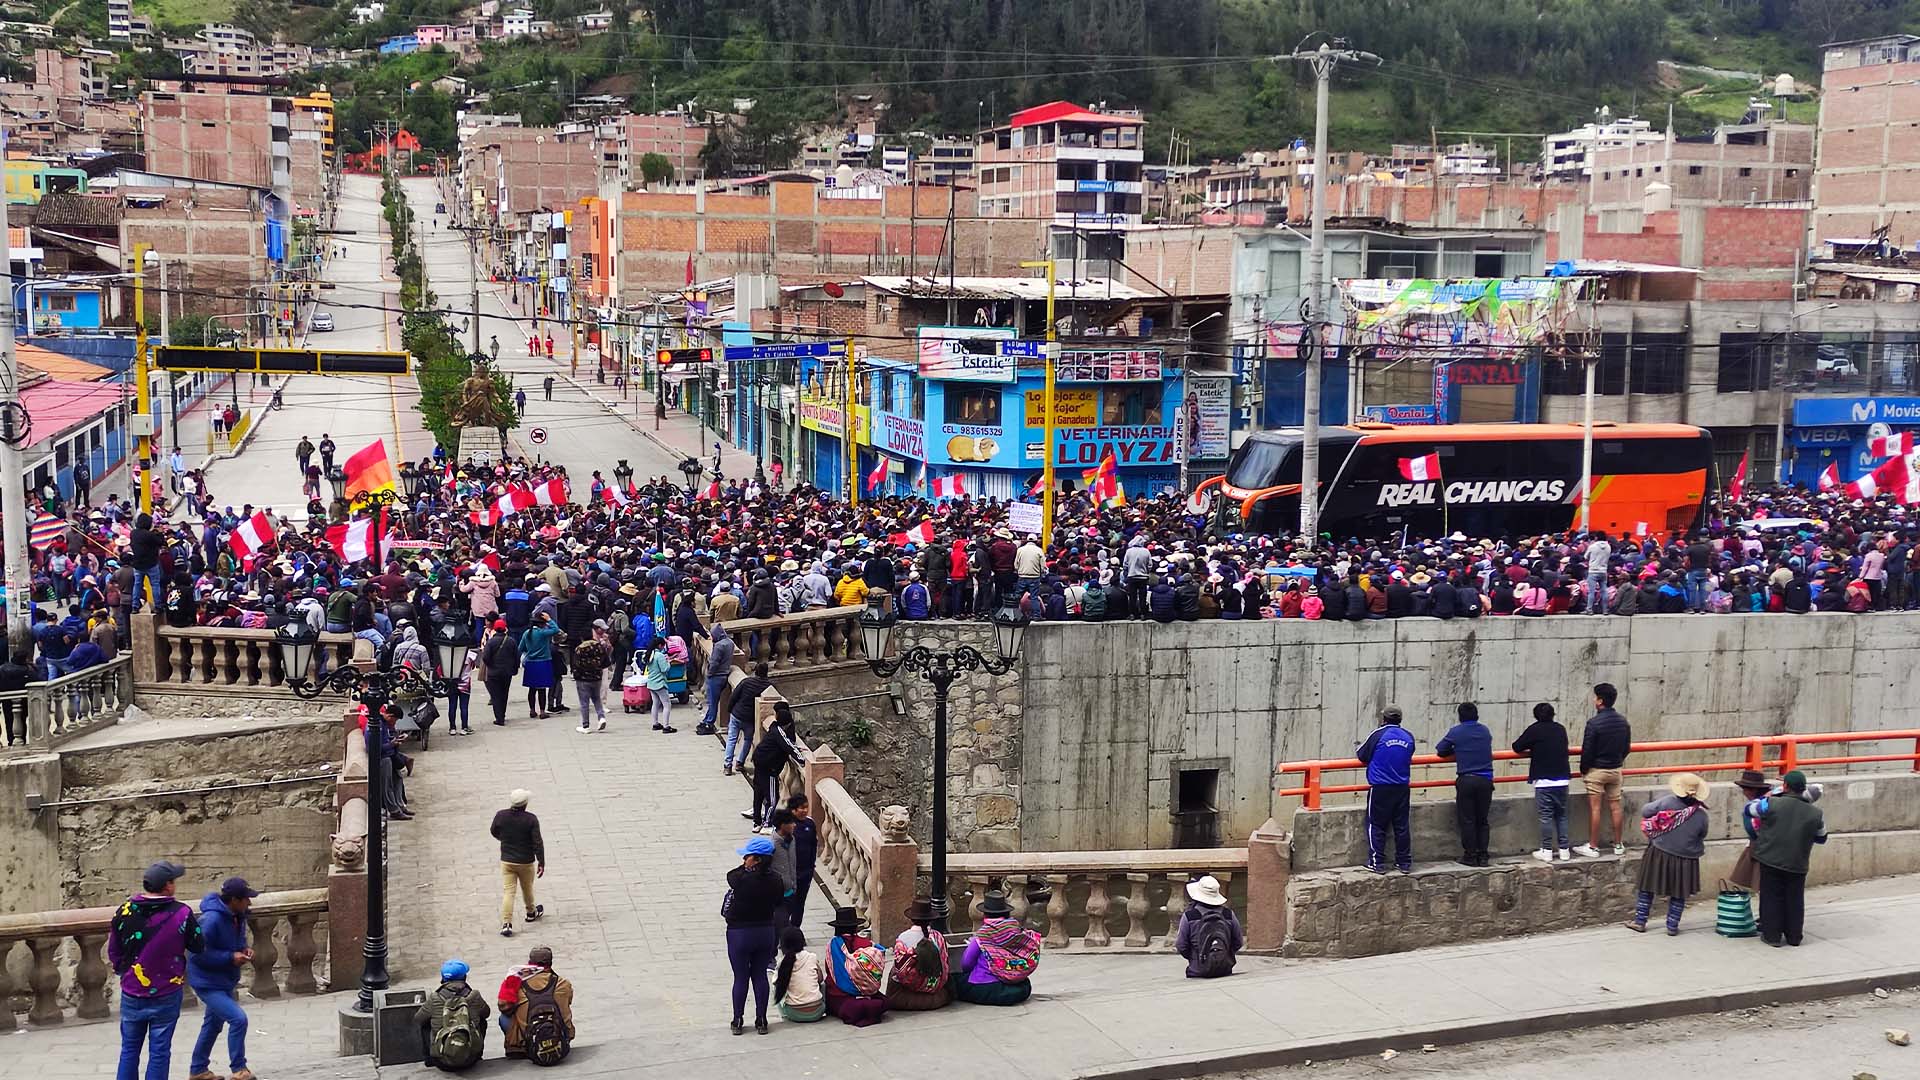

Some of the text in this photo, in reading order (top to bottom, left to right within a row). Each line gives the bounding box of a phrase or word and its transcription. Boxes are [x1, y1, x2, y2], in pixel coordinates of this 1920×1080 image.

[1435, 366, 1444, 425] DENTA
[884, 414, 924, 436] VETERINARIA
[960, 426, 1003, 436] 983615329
[1061, 427, 1174, 440] VETERINARIA
[1800, 429, 1851, 442] VEGA
[888, 428, 924, 458] LOAYZA
[1175, 417, 1184, 460] DENTAL
[1059, 441, 1174, 464] LOAYZA
[1376, 480, 1566, 507] REAL CHANCAS
